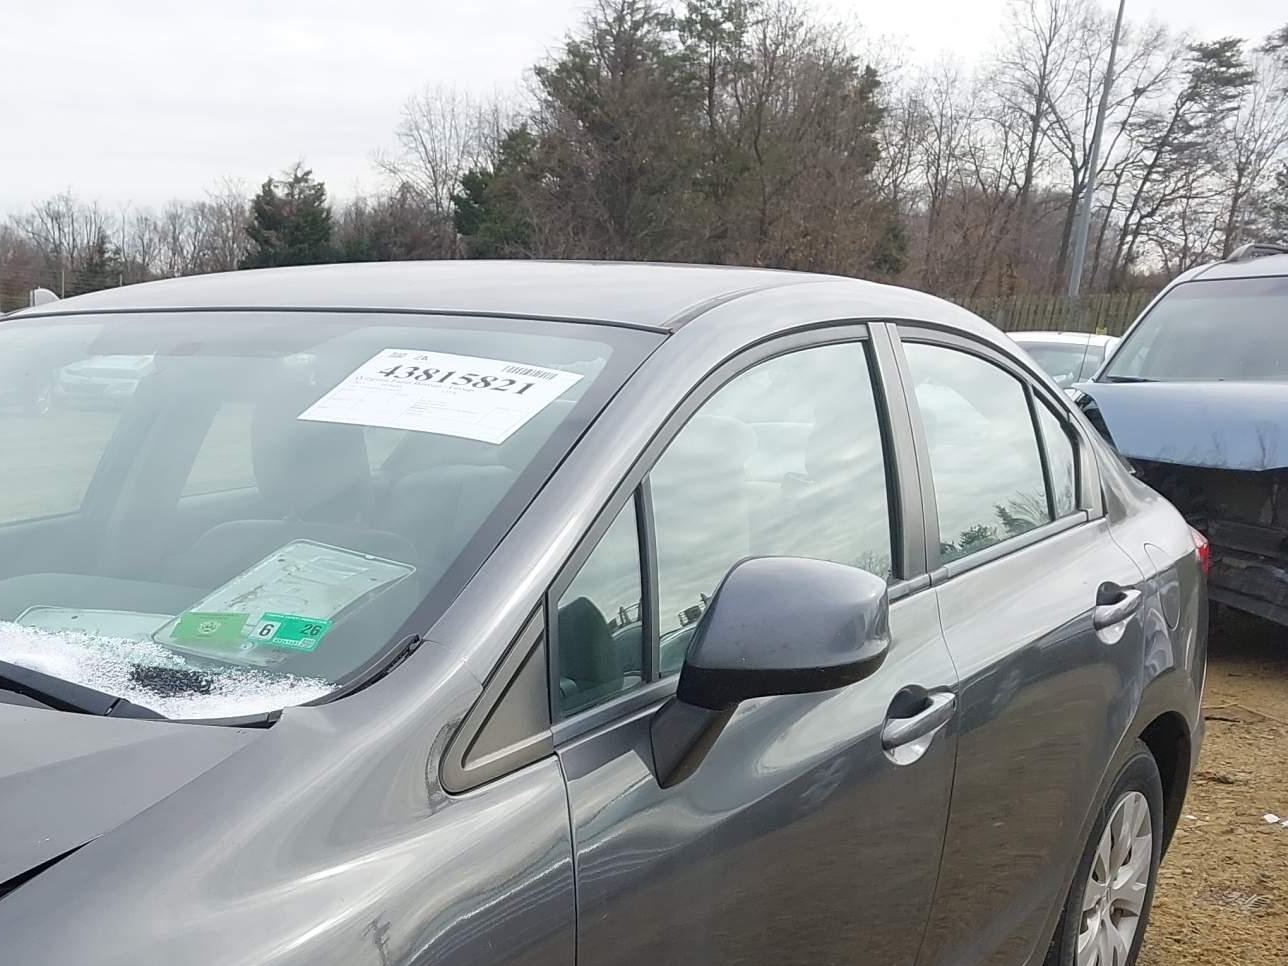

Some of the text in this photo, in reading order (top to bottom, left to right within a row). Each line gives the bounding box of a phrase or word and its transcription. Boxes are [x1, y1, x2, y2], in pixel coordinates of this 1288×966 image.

[377, 364, 536, 395] 43815821
[258, 623, 323, 637] 6 26
